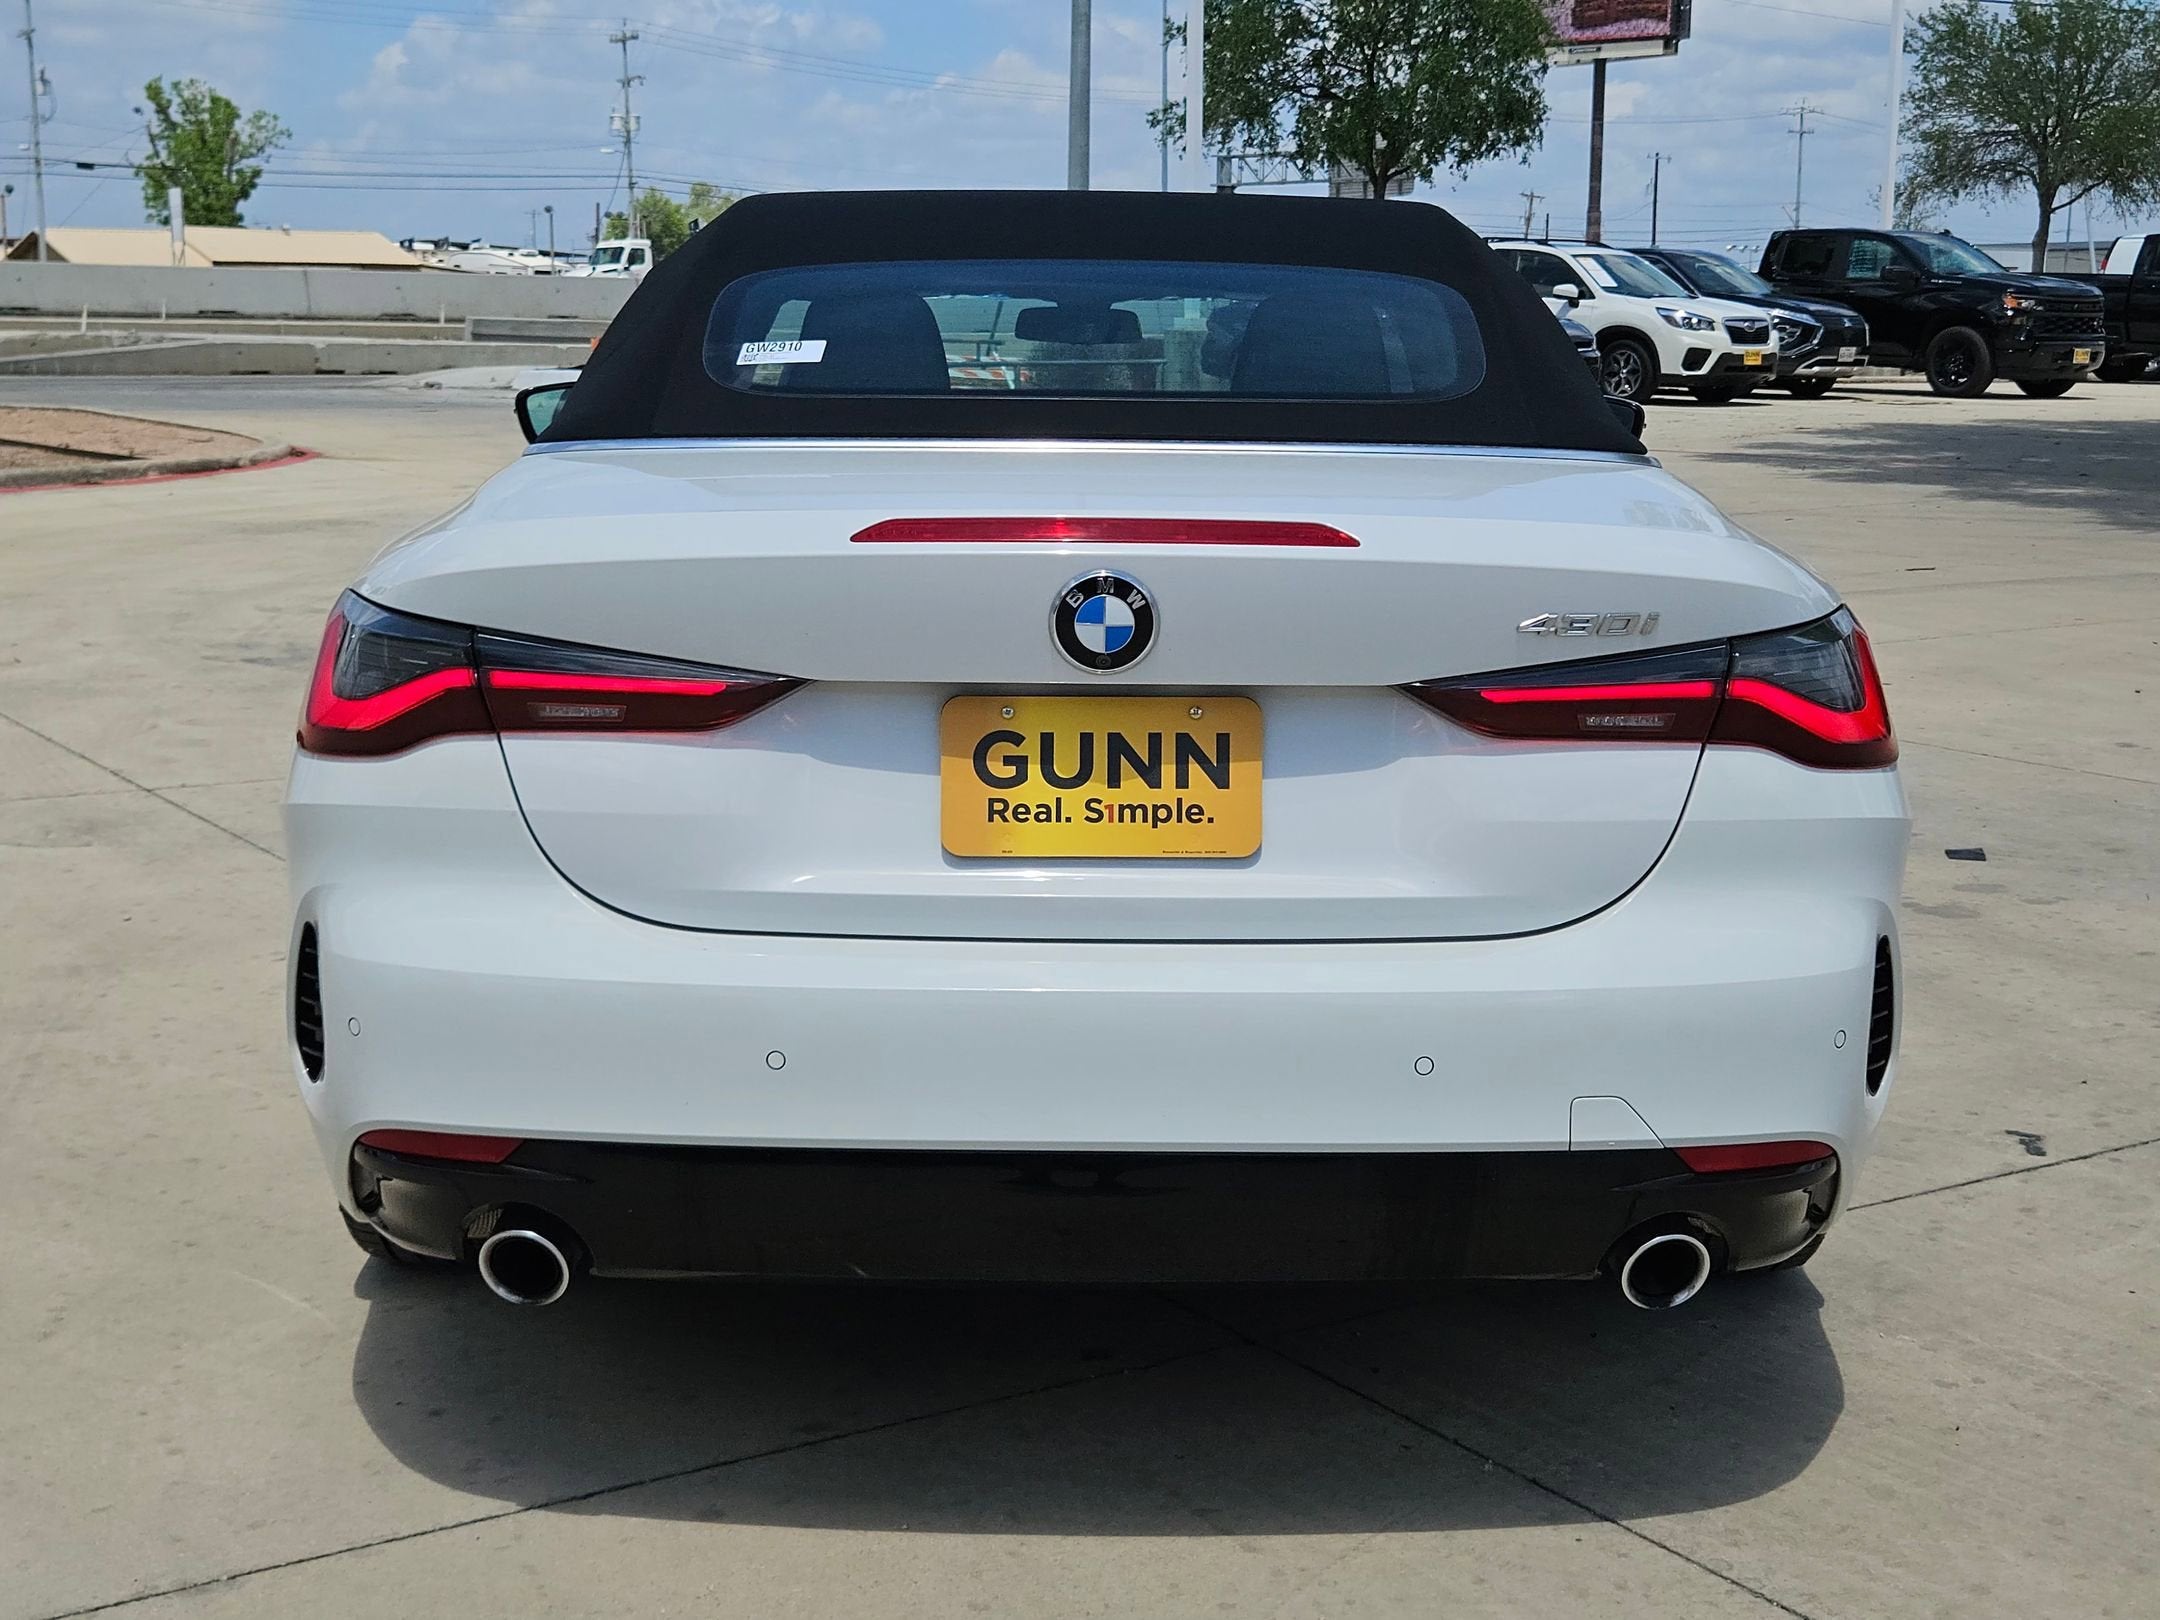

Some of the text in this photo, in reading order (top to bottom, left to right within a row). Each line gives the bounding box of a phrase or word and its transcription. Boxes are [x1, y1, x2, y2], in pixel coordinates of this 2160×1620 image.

[746, 342, 803, 353] GW2910
[1065, 577, 1147, 610] BMW
[1516, 612, 1661, 637] 430i
[972, 729, 1231, 790] GUNN
[987, 797, 1215, 829] Real. S1mple.
